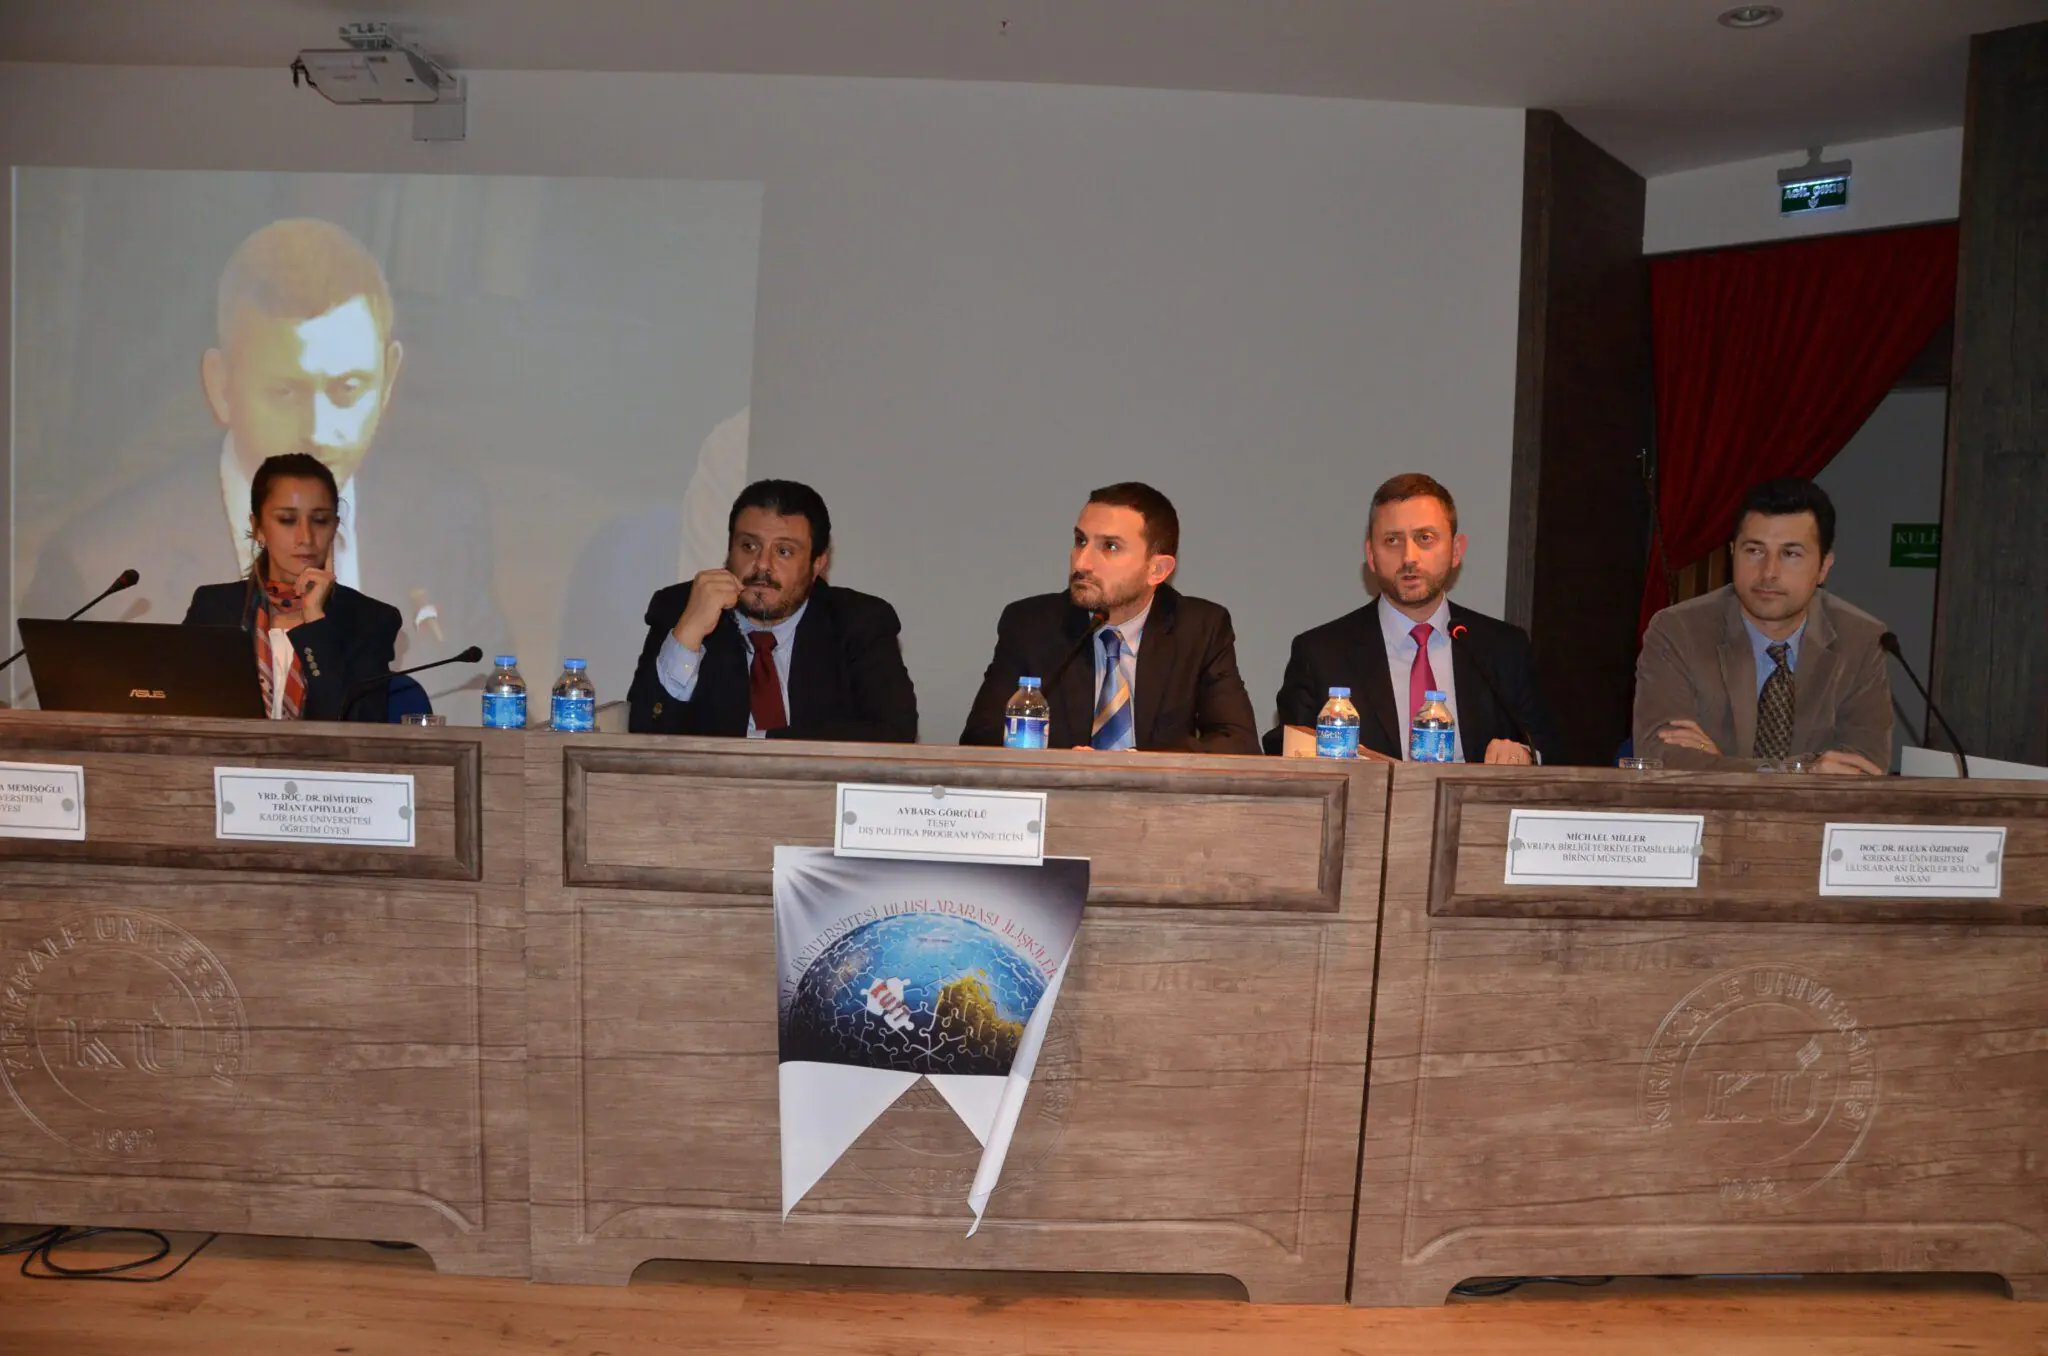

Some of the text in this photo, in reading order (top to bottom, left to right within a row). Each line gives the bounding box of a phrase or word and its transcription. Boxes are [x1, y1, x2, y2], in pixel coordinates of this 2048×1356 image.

[1895, 529, 1940, 545] KULİ
[130, 688, 166, 699] ASUS
[258, 792, 280, 801] YRD.
[305, 794, 321, 802] DR.
[897, 807, 987, 819] AYBARS GÖRGÜLÜ
[290, 814, 308, 823] HAS
[927, 819, 957, 828] TESEV
[921, 829, 968, 840] PROGRAM
[1897, 845, 1928, 853] HALUK
